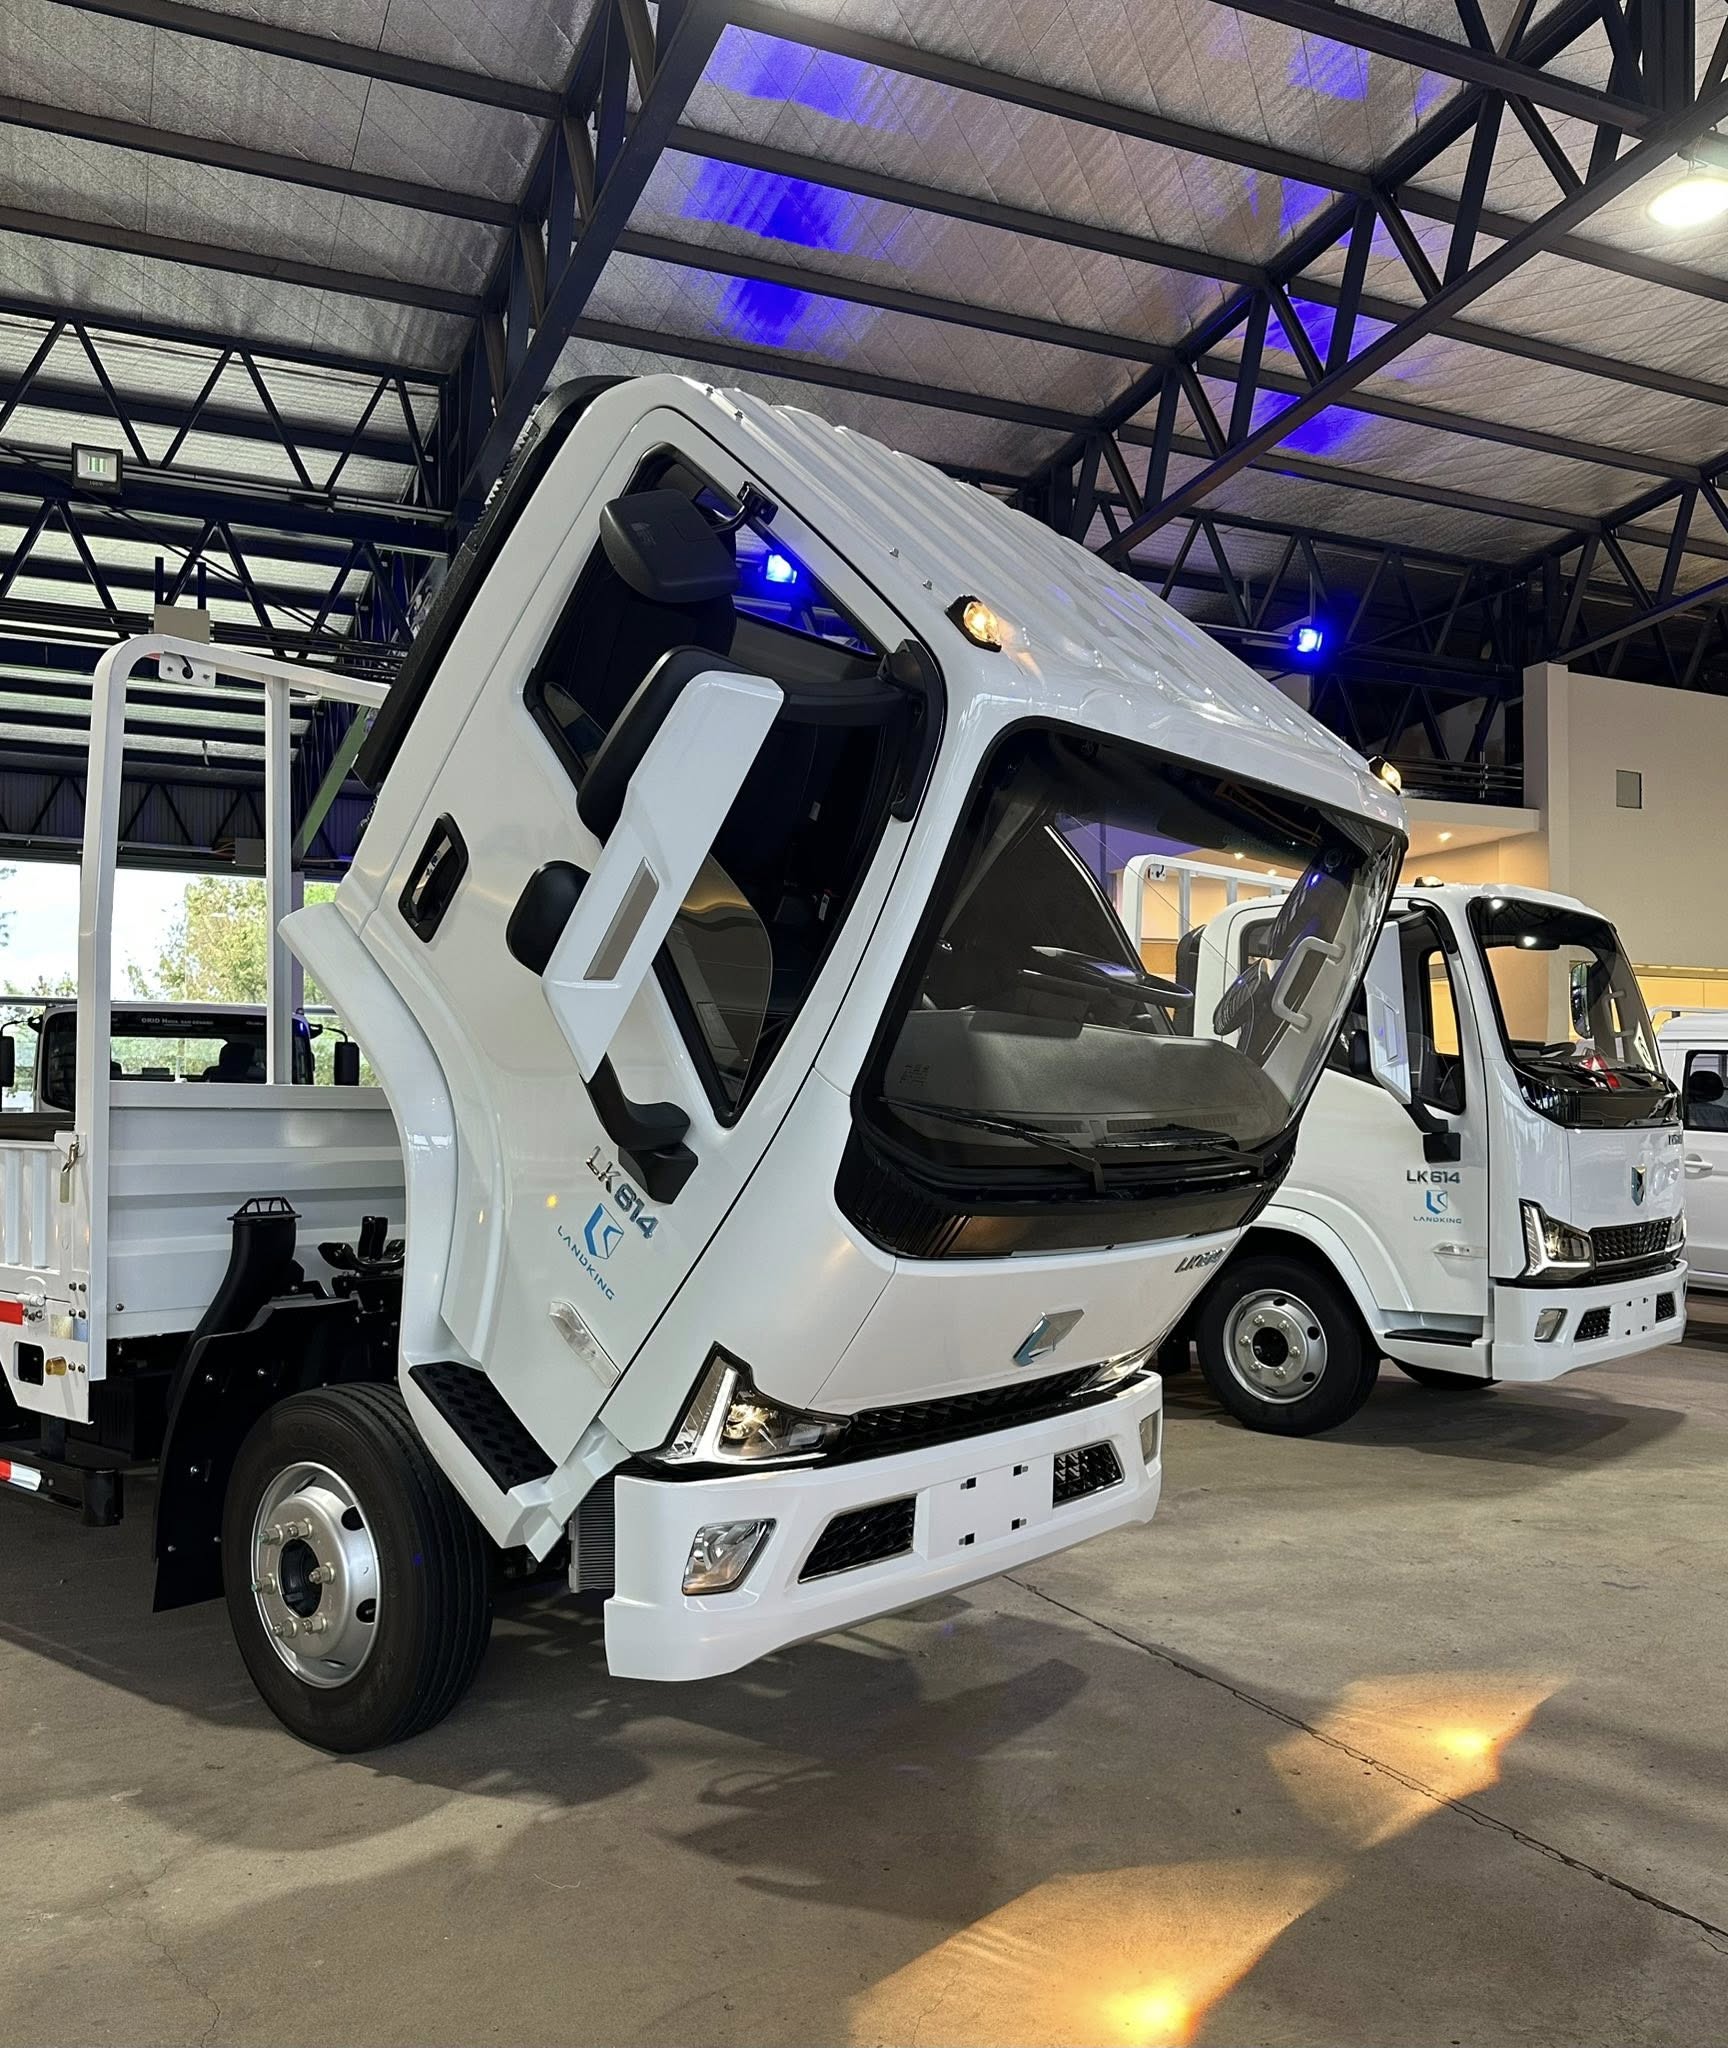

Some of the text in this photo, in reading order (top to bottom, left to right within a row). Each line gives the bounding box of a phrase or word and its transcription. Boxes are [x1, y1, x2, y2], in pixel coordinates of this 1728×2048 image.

[1406, 1169, 1461, 1184] LK614
[1412, 1215, 1462, 1224] LANDKING
[556, 1224, 616, 1301] LANDKING
